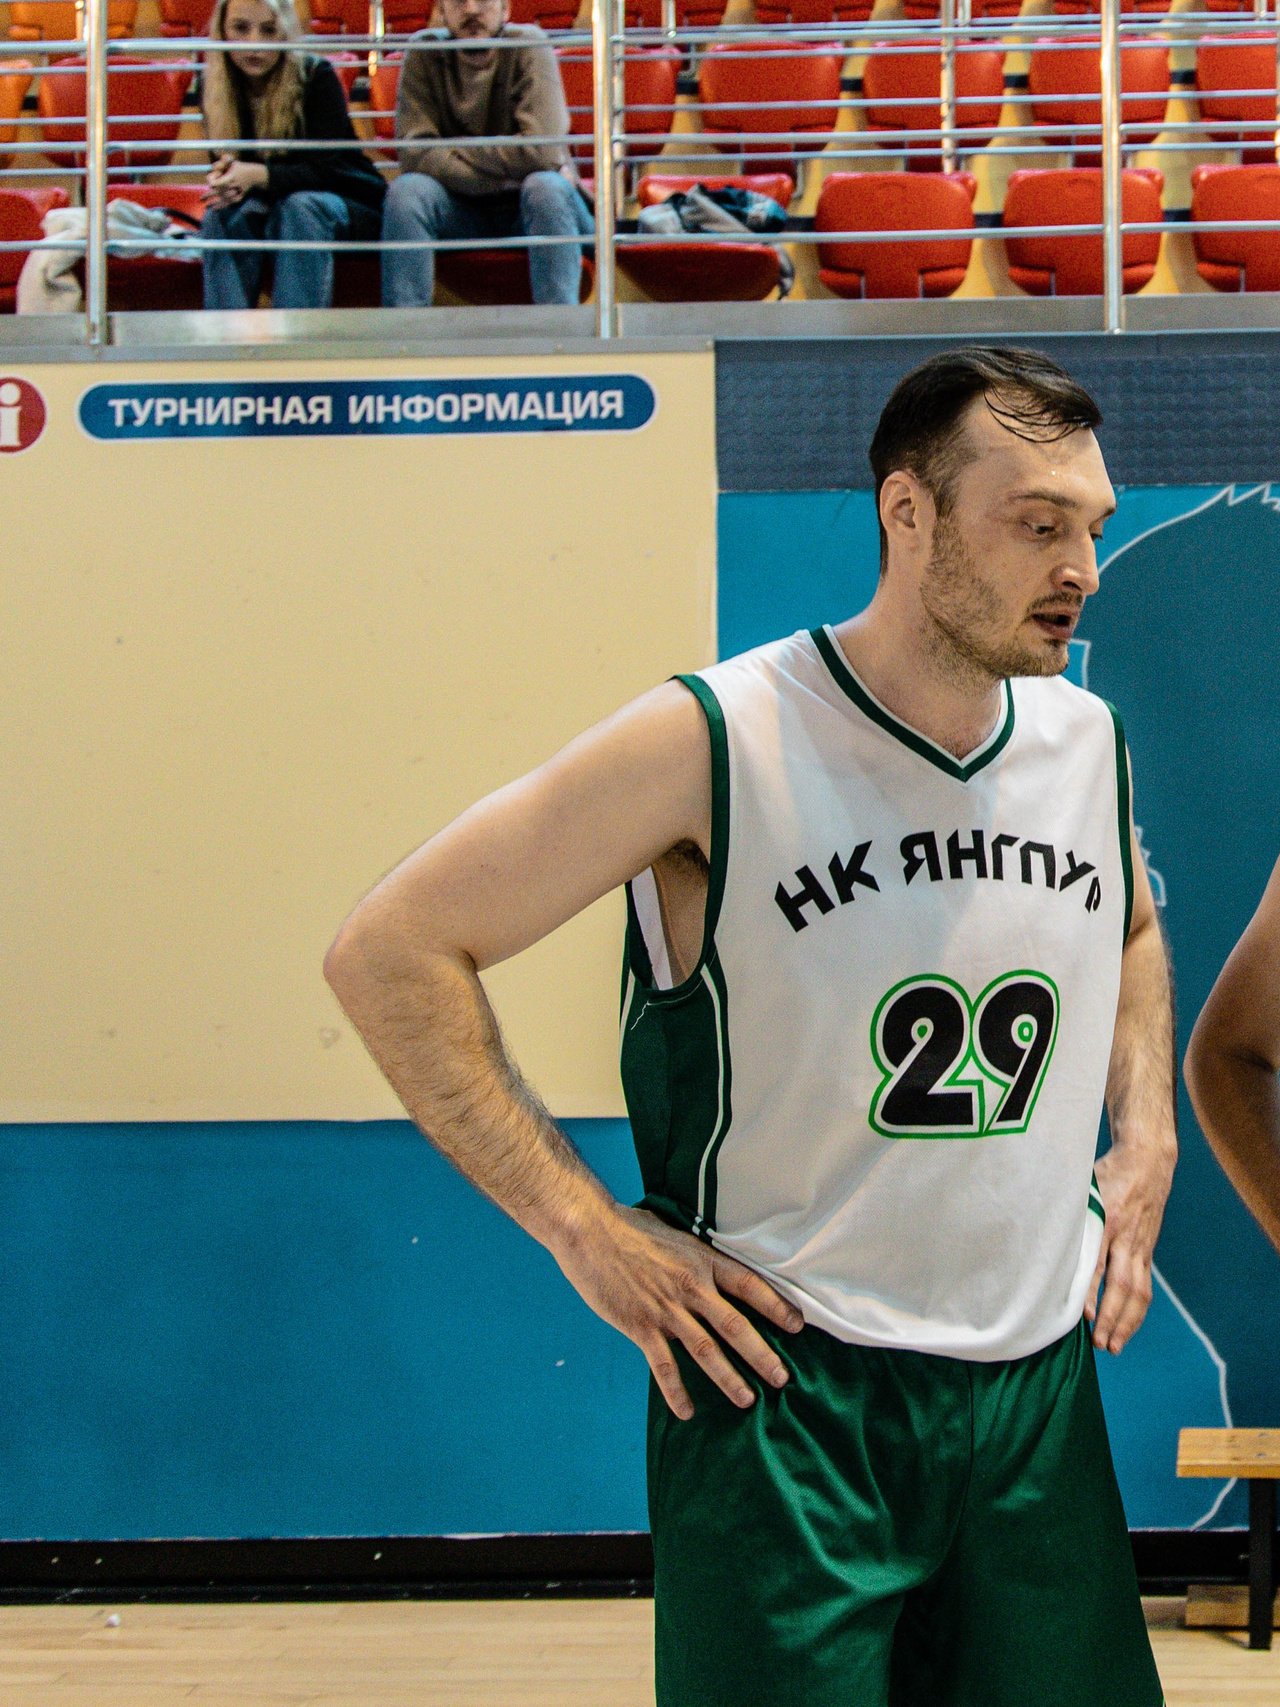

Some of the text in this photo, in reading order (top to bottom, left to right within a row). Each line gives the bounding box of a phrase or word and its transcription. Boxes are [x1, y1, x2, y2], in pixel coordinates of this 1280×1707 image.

[109, 390, 624, 427] ТУРНИРНАЯ ИНФОРМАЦИЯ
[774, 840, 881, 933] НК
[868, 969, 1060, 1139] 29
